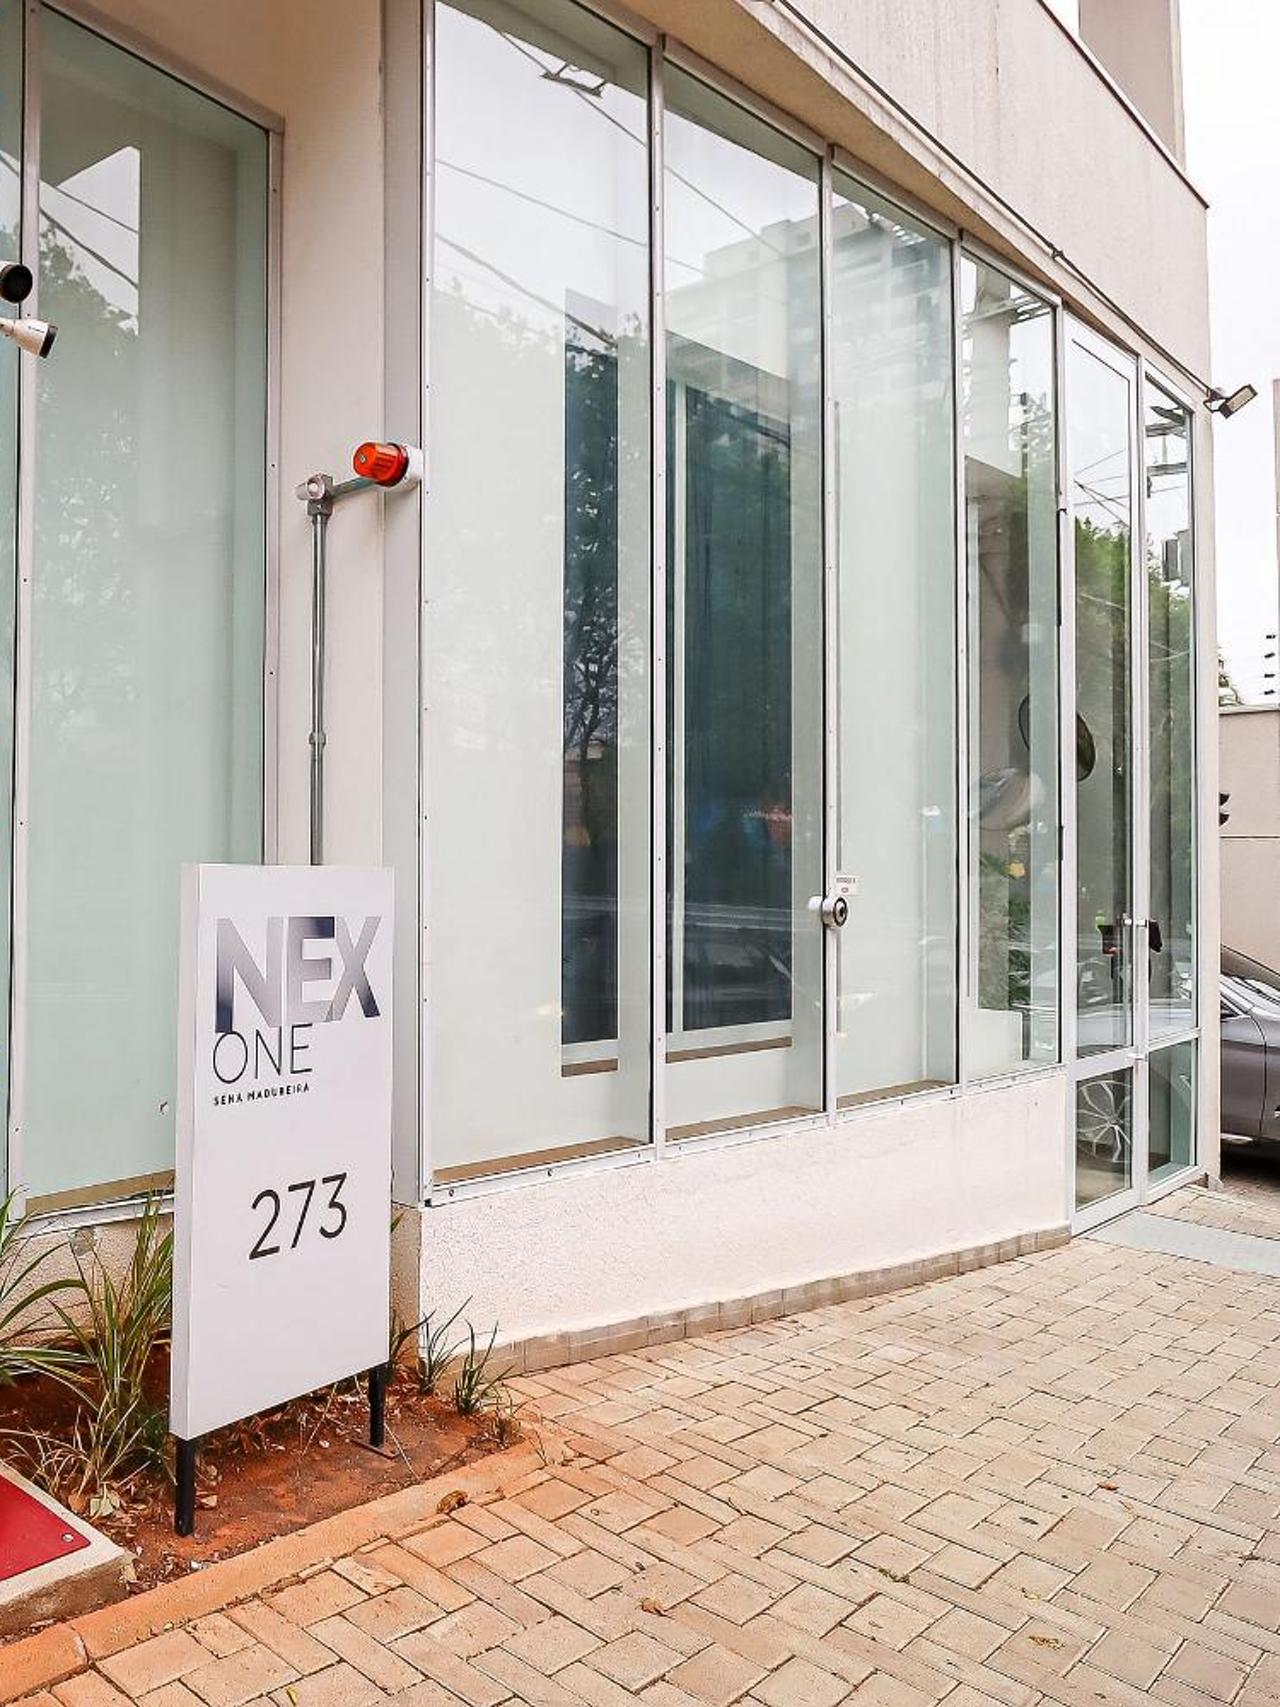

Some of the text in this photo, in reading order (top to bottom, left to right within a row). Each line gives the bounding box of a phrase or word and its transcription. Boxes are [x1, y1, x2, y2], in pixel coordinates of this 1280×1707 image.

[214, 916, 382, 1033] NEX
[212, 1023, 312, 1084] ONE
[213, 1083, 309, 1106] SENA MADUREIRA
[248, 1172, 348, 1260] 273
